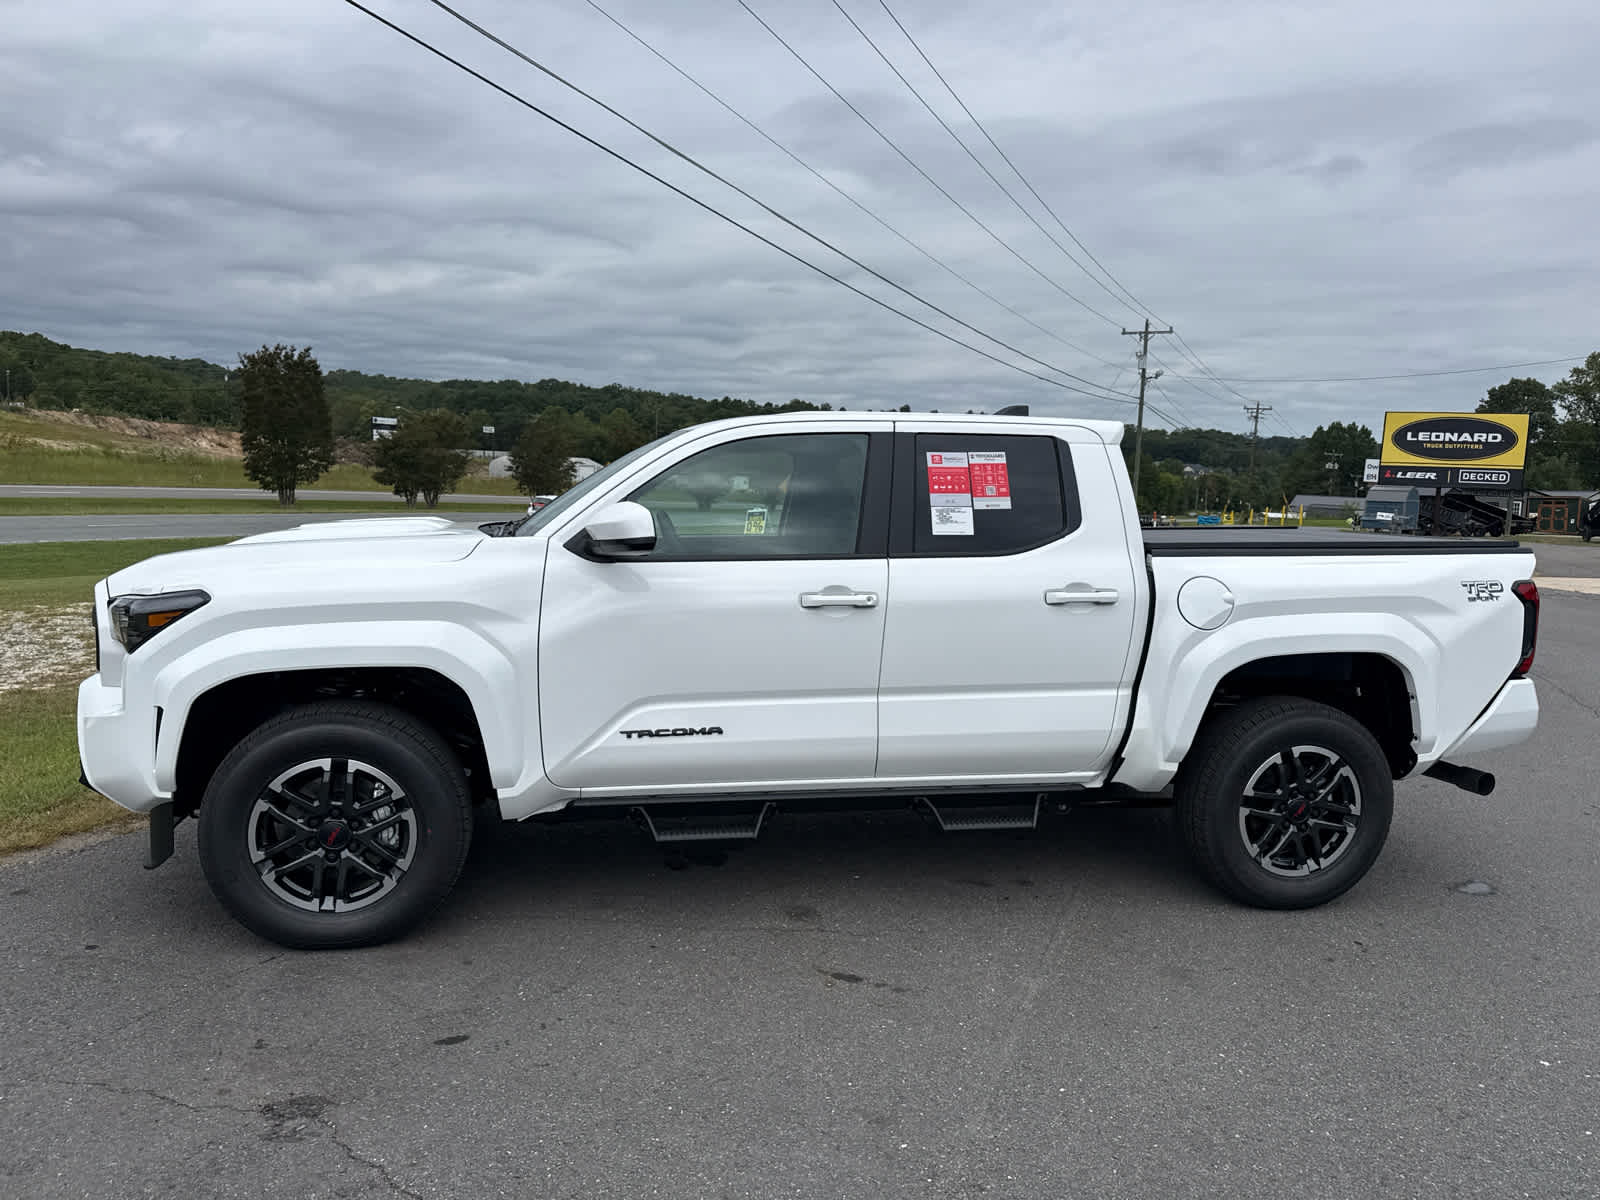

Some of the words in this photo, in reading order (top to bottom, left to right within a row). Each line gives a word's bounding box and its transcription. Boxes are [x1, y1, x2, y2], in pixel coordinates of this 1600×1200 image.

[1406, 431, 1502, 443] LEONARD
[1396, 471, 1437, 480] LEER
[1462, 472, 1507, 481] DECKED
[1461, 580, 1504, 597] TRD
[619, 726, 724, 739] TACOMA
